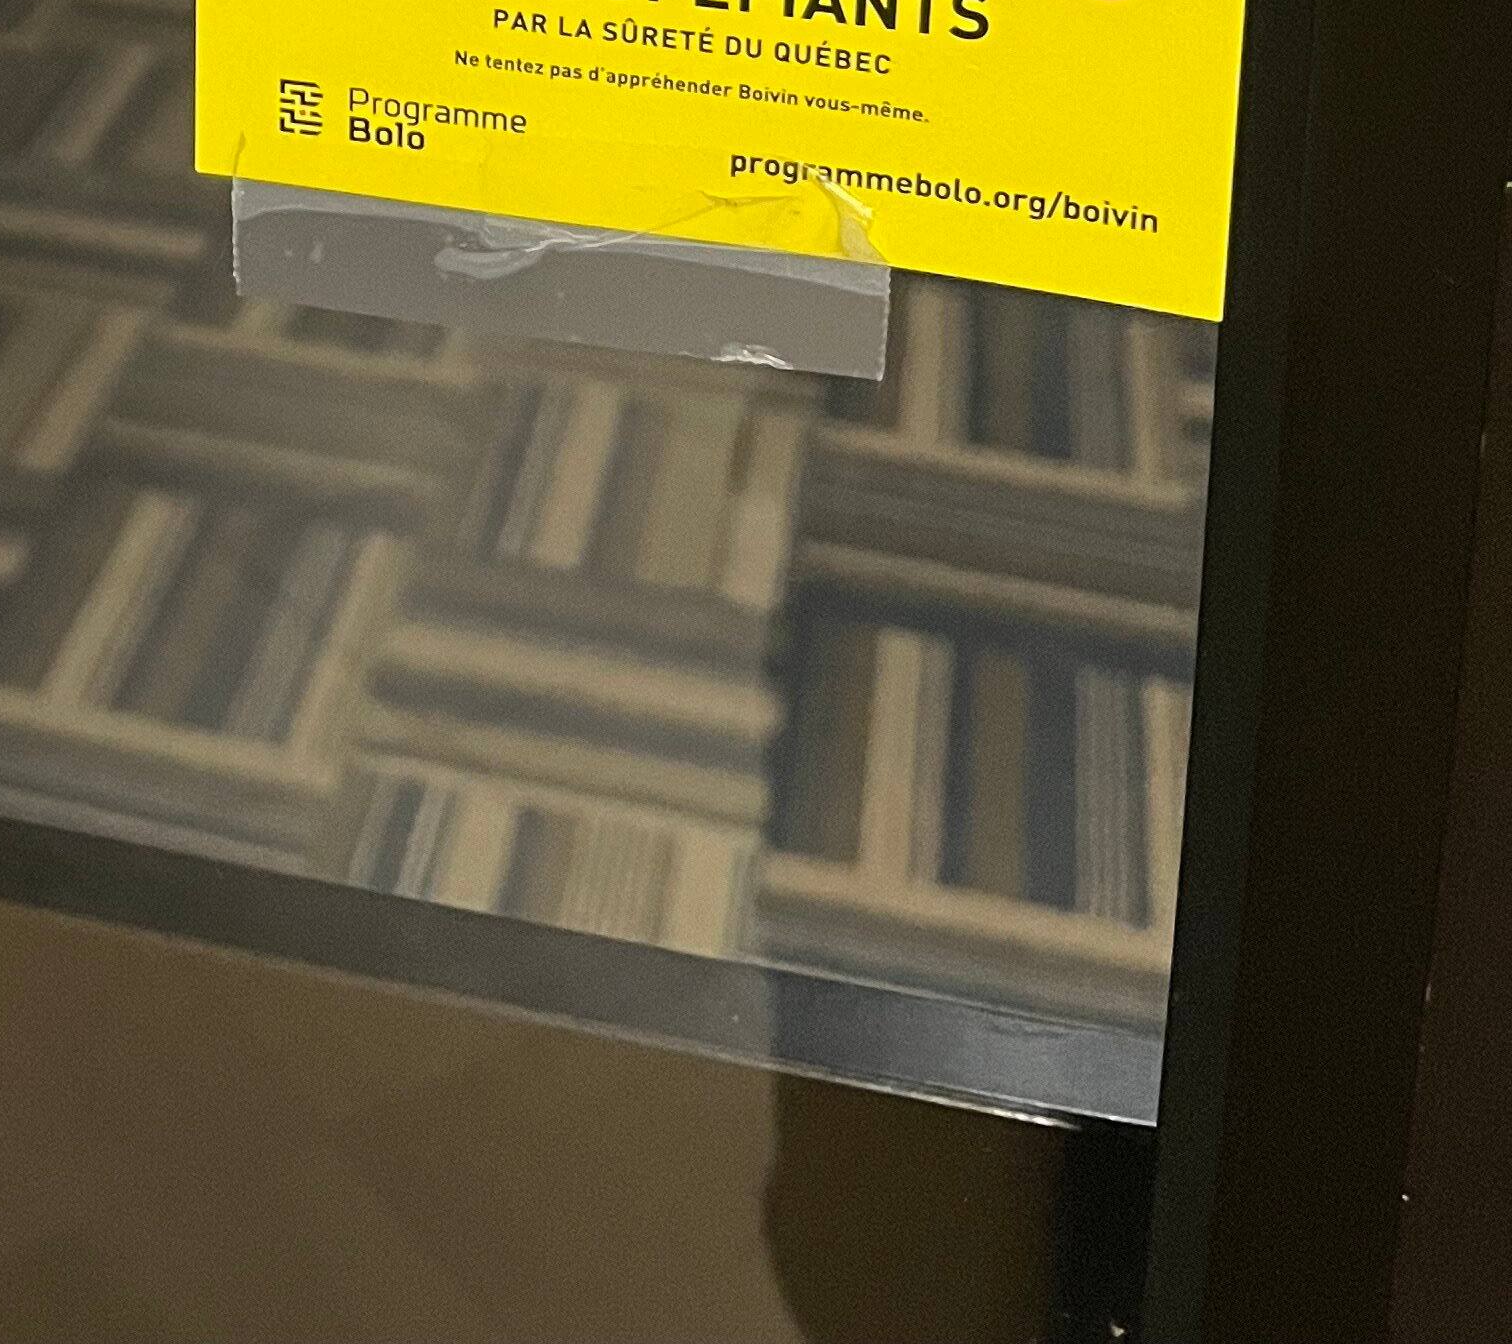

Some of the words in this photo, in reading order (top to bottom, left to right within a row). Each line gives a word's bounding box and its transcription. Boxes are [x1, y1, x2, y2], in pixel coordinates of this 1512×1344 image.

[493, 8, 547, 35] PAR
[558, 15, 593, 40] LA
[602, 17, 714, 54] SÛRETÉ
[725, 35, 762, 59] DU
[774, 39, 891, 75] QUÉBEC
[348, 87, 527, 134] Programme
[454, 49, 480, 67] Ne
[485, 54, 544, 75] tentez
[549, 63, 583, 82] pas
[588, 66, 733, 99] d'appréhender
[738, 83, 799, 105] Boivin
[804, 92, 930, 123] vous-même.
[348, 115, 426, 151] Bolo
[729, 153, 1159, 234] programmebolo.org/boivin
